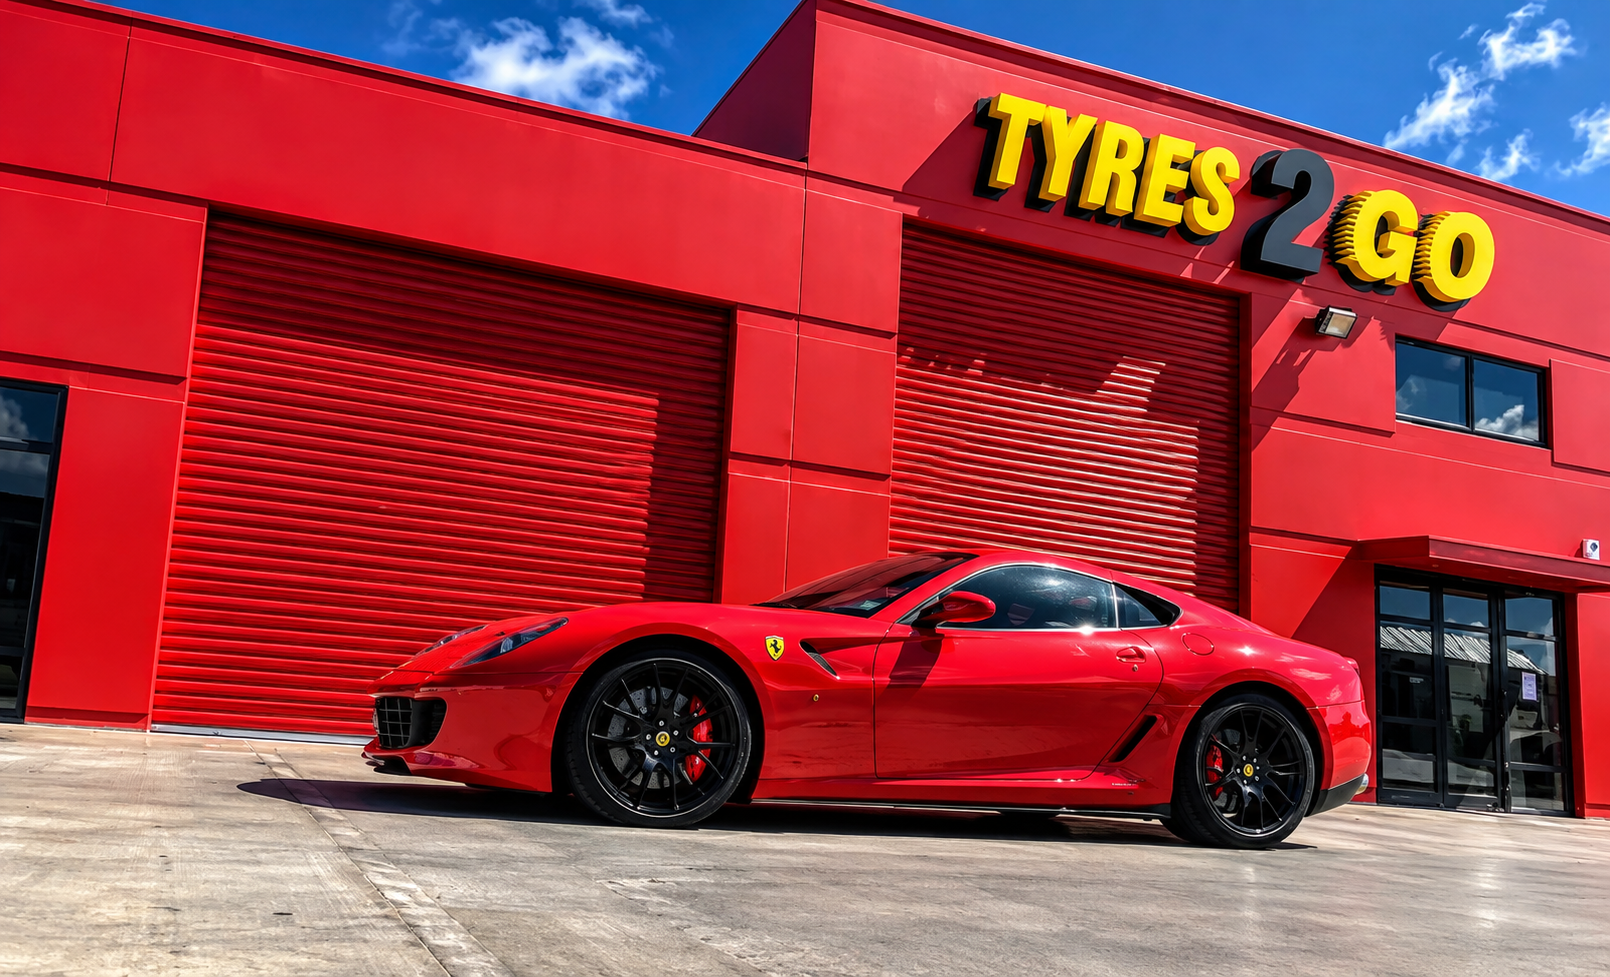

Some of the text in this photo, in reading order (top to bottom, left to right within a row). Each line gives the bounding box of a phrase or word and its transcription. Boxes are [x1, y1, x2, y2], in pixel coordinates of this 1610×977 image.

[986, 92, 1495, 303] TYRES 2 GO
